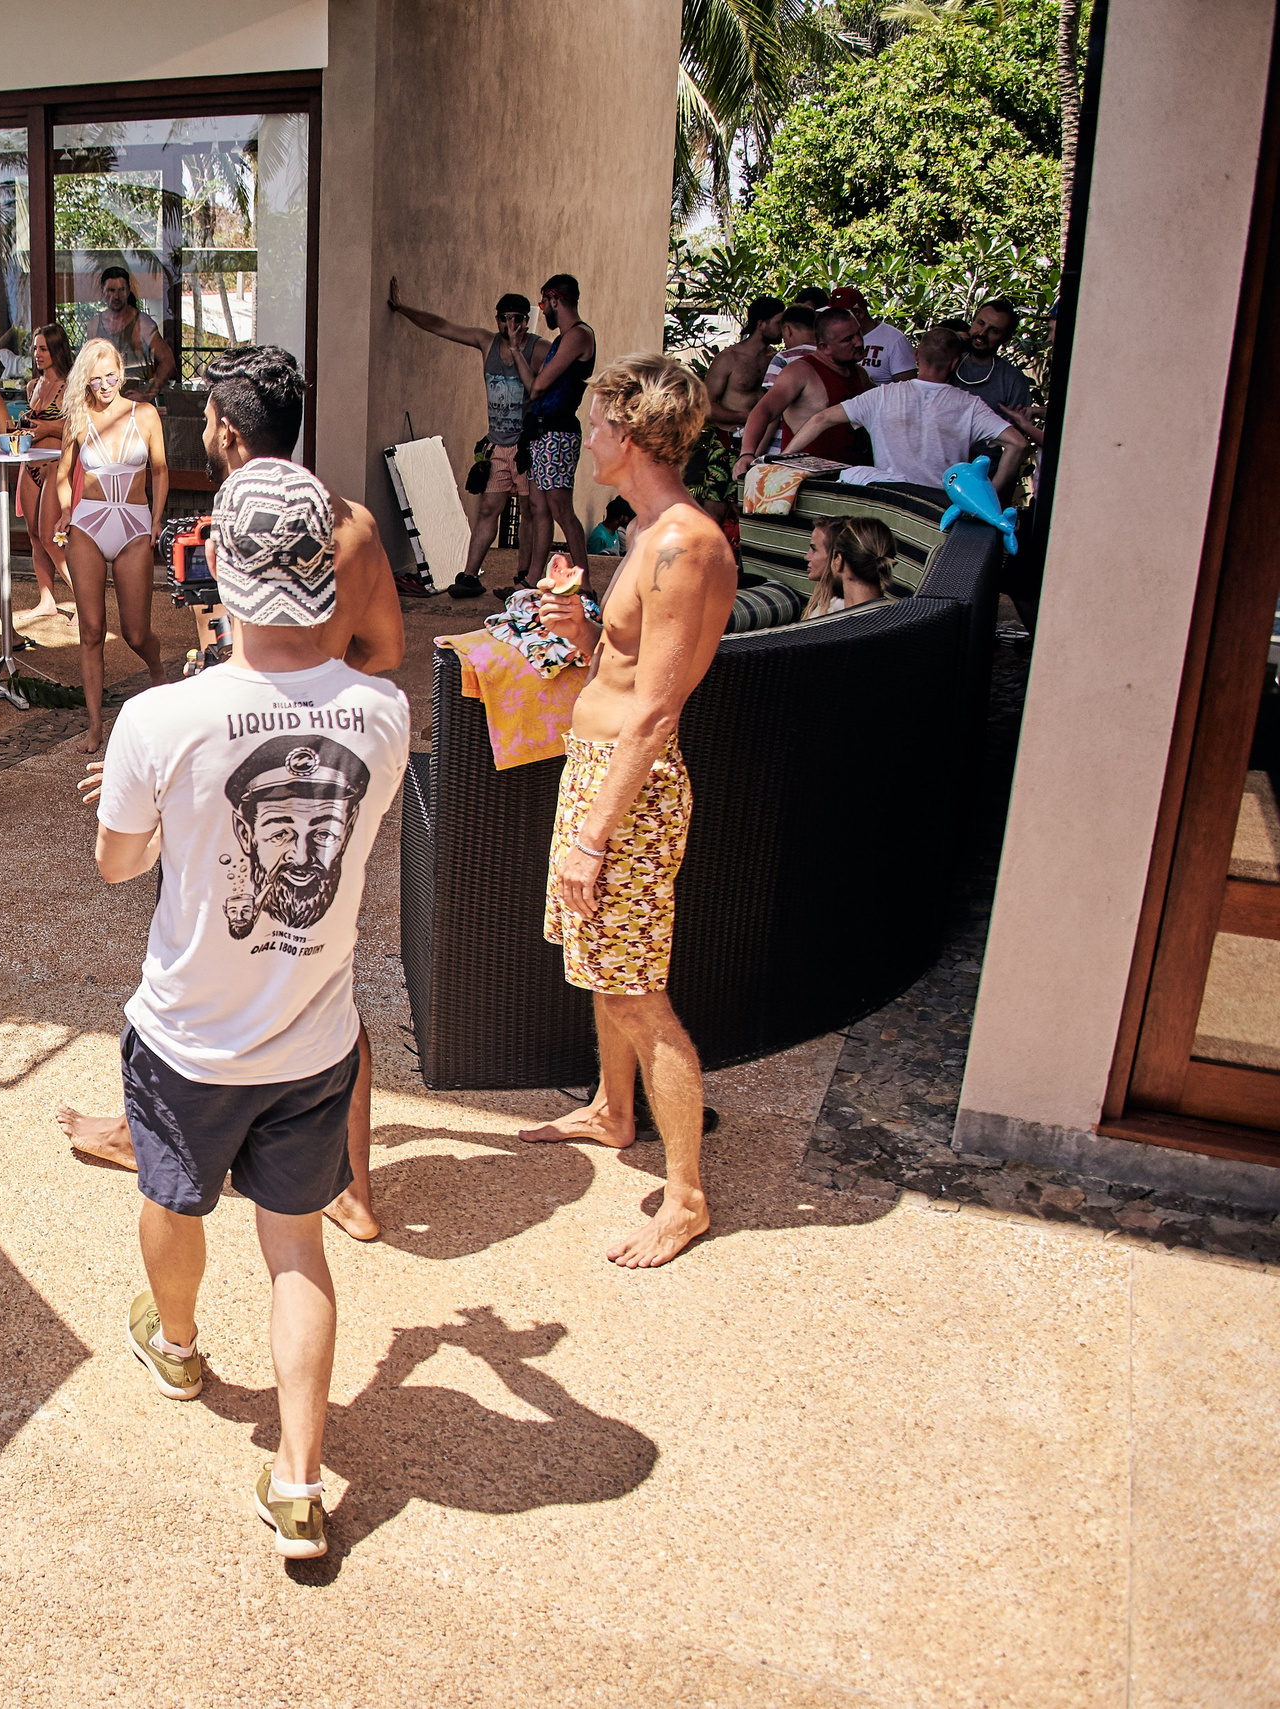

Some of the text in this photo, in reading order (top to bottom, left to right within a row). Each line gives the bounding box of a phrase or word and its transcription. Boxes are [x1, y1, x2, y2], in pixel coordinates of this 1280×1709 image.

[272, 701, 315, 709] BILLABONG
[227, 707, 365, 741] LIQUID HIGH
[272, 930, 307, 944] SINCE 1973
[250, 941, 326, 957] DIAL 1800 FROTHY
